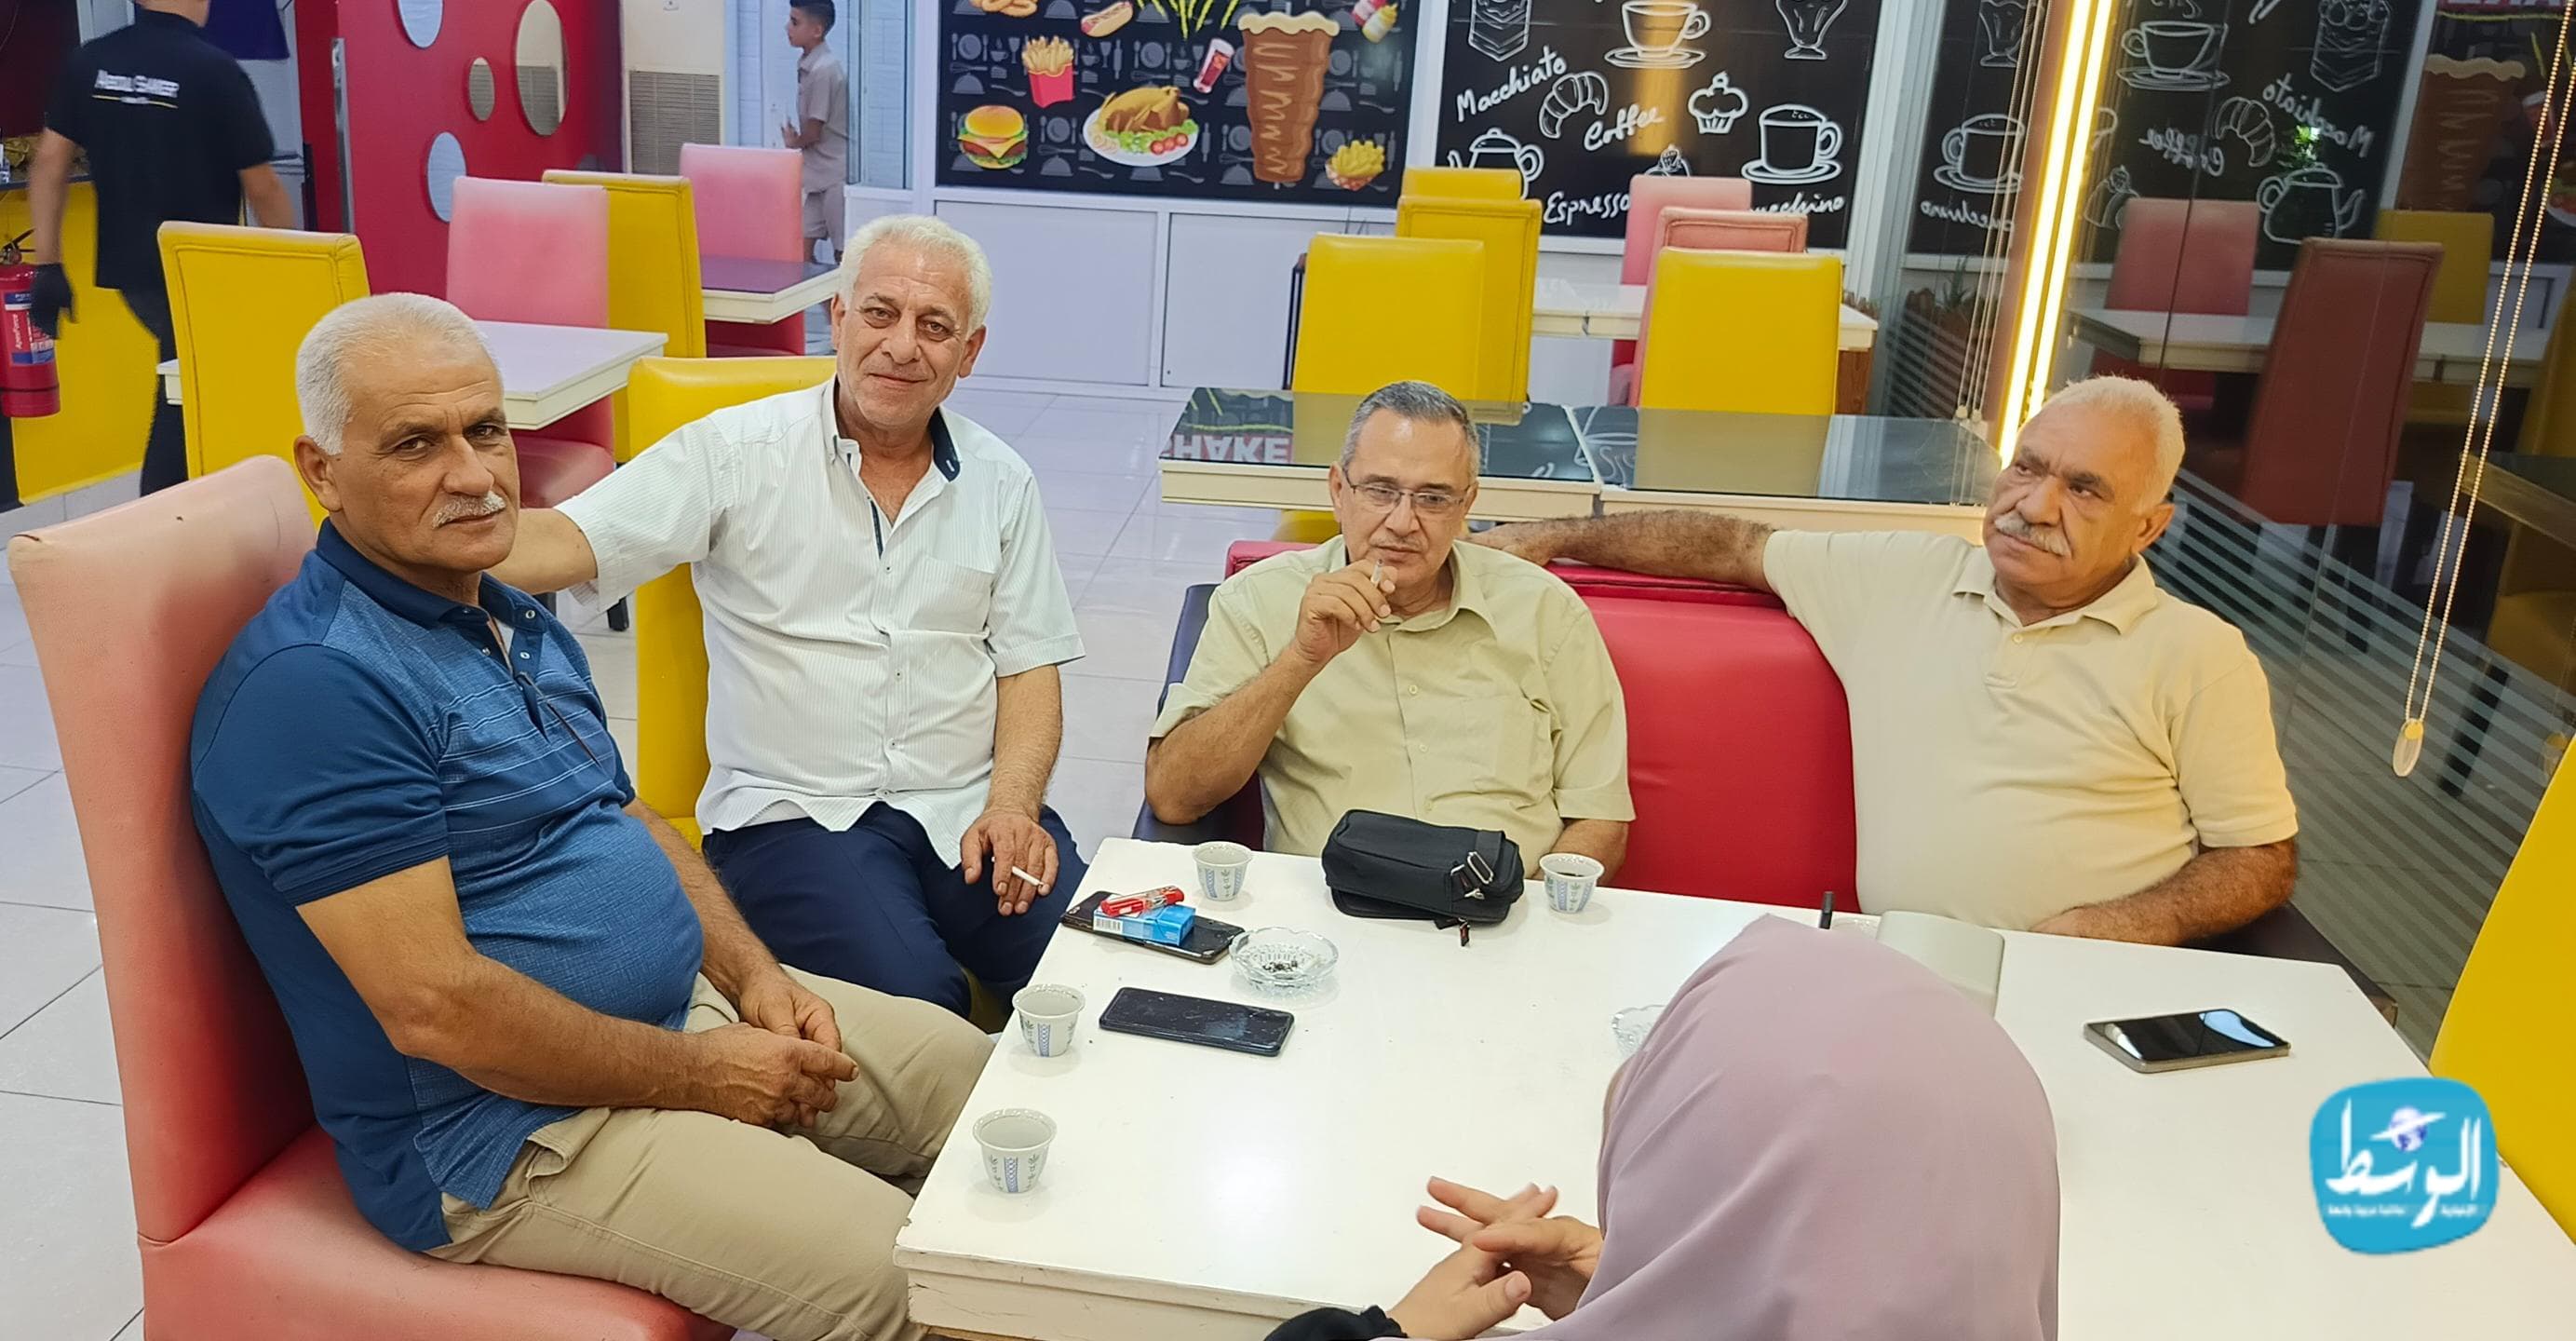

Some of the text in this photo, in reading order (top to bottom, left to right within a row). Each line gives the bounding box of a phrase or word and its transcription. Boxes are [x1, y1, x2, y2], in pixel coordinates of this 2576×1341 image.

[1457, 45, 1568, 123] Macchiato
[1584, 103, 1666, 151] Coffee
[1543, 191, 1629, 225] Espresso
